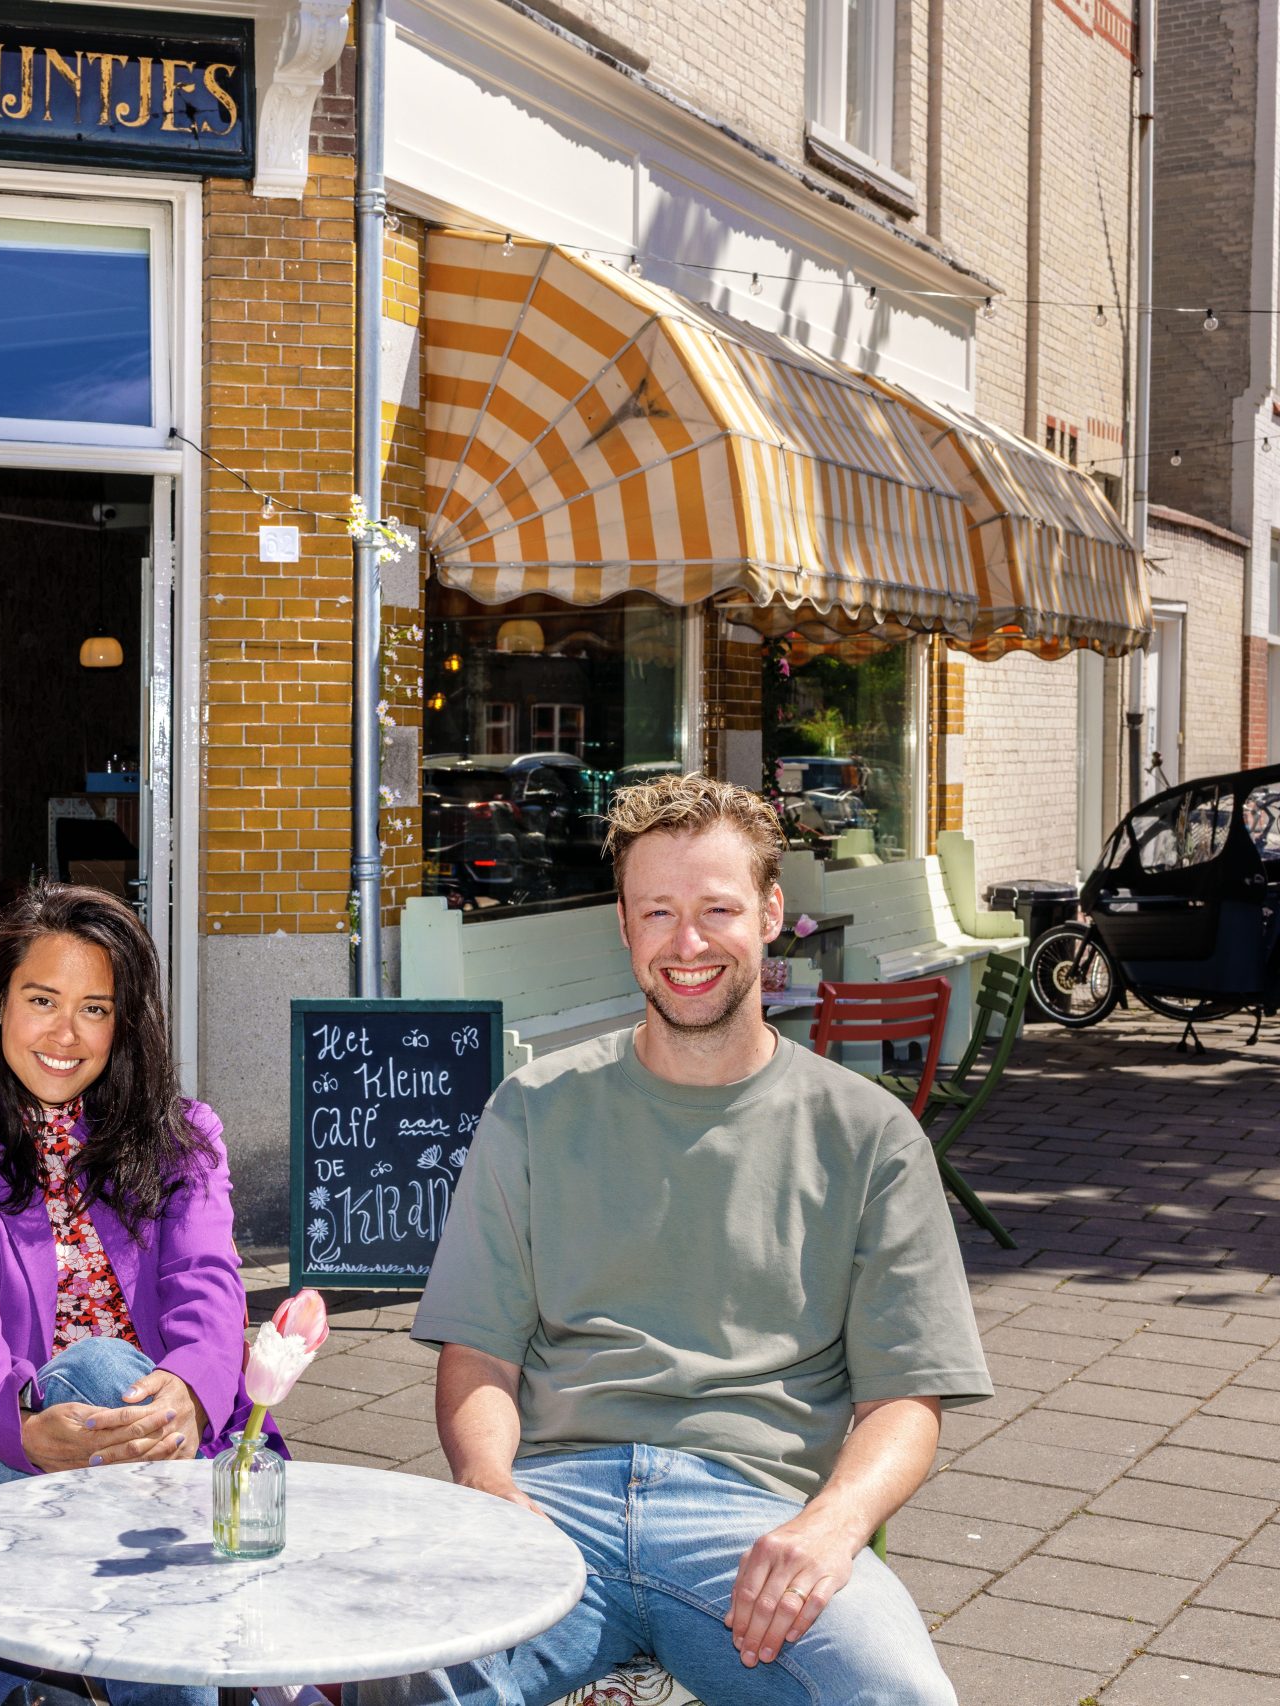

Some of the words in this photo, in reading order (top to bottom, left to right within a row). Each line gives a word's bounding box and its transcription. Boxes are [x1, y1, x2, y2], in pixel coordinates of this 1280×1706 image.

[312, 1024, 373, 1060] Het
[311, 1103, 380, 1149] Café
[399, 1117, 450, 1131] aan
[314, 1159, 345, 1181] DE
